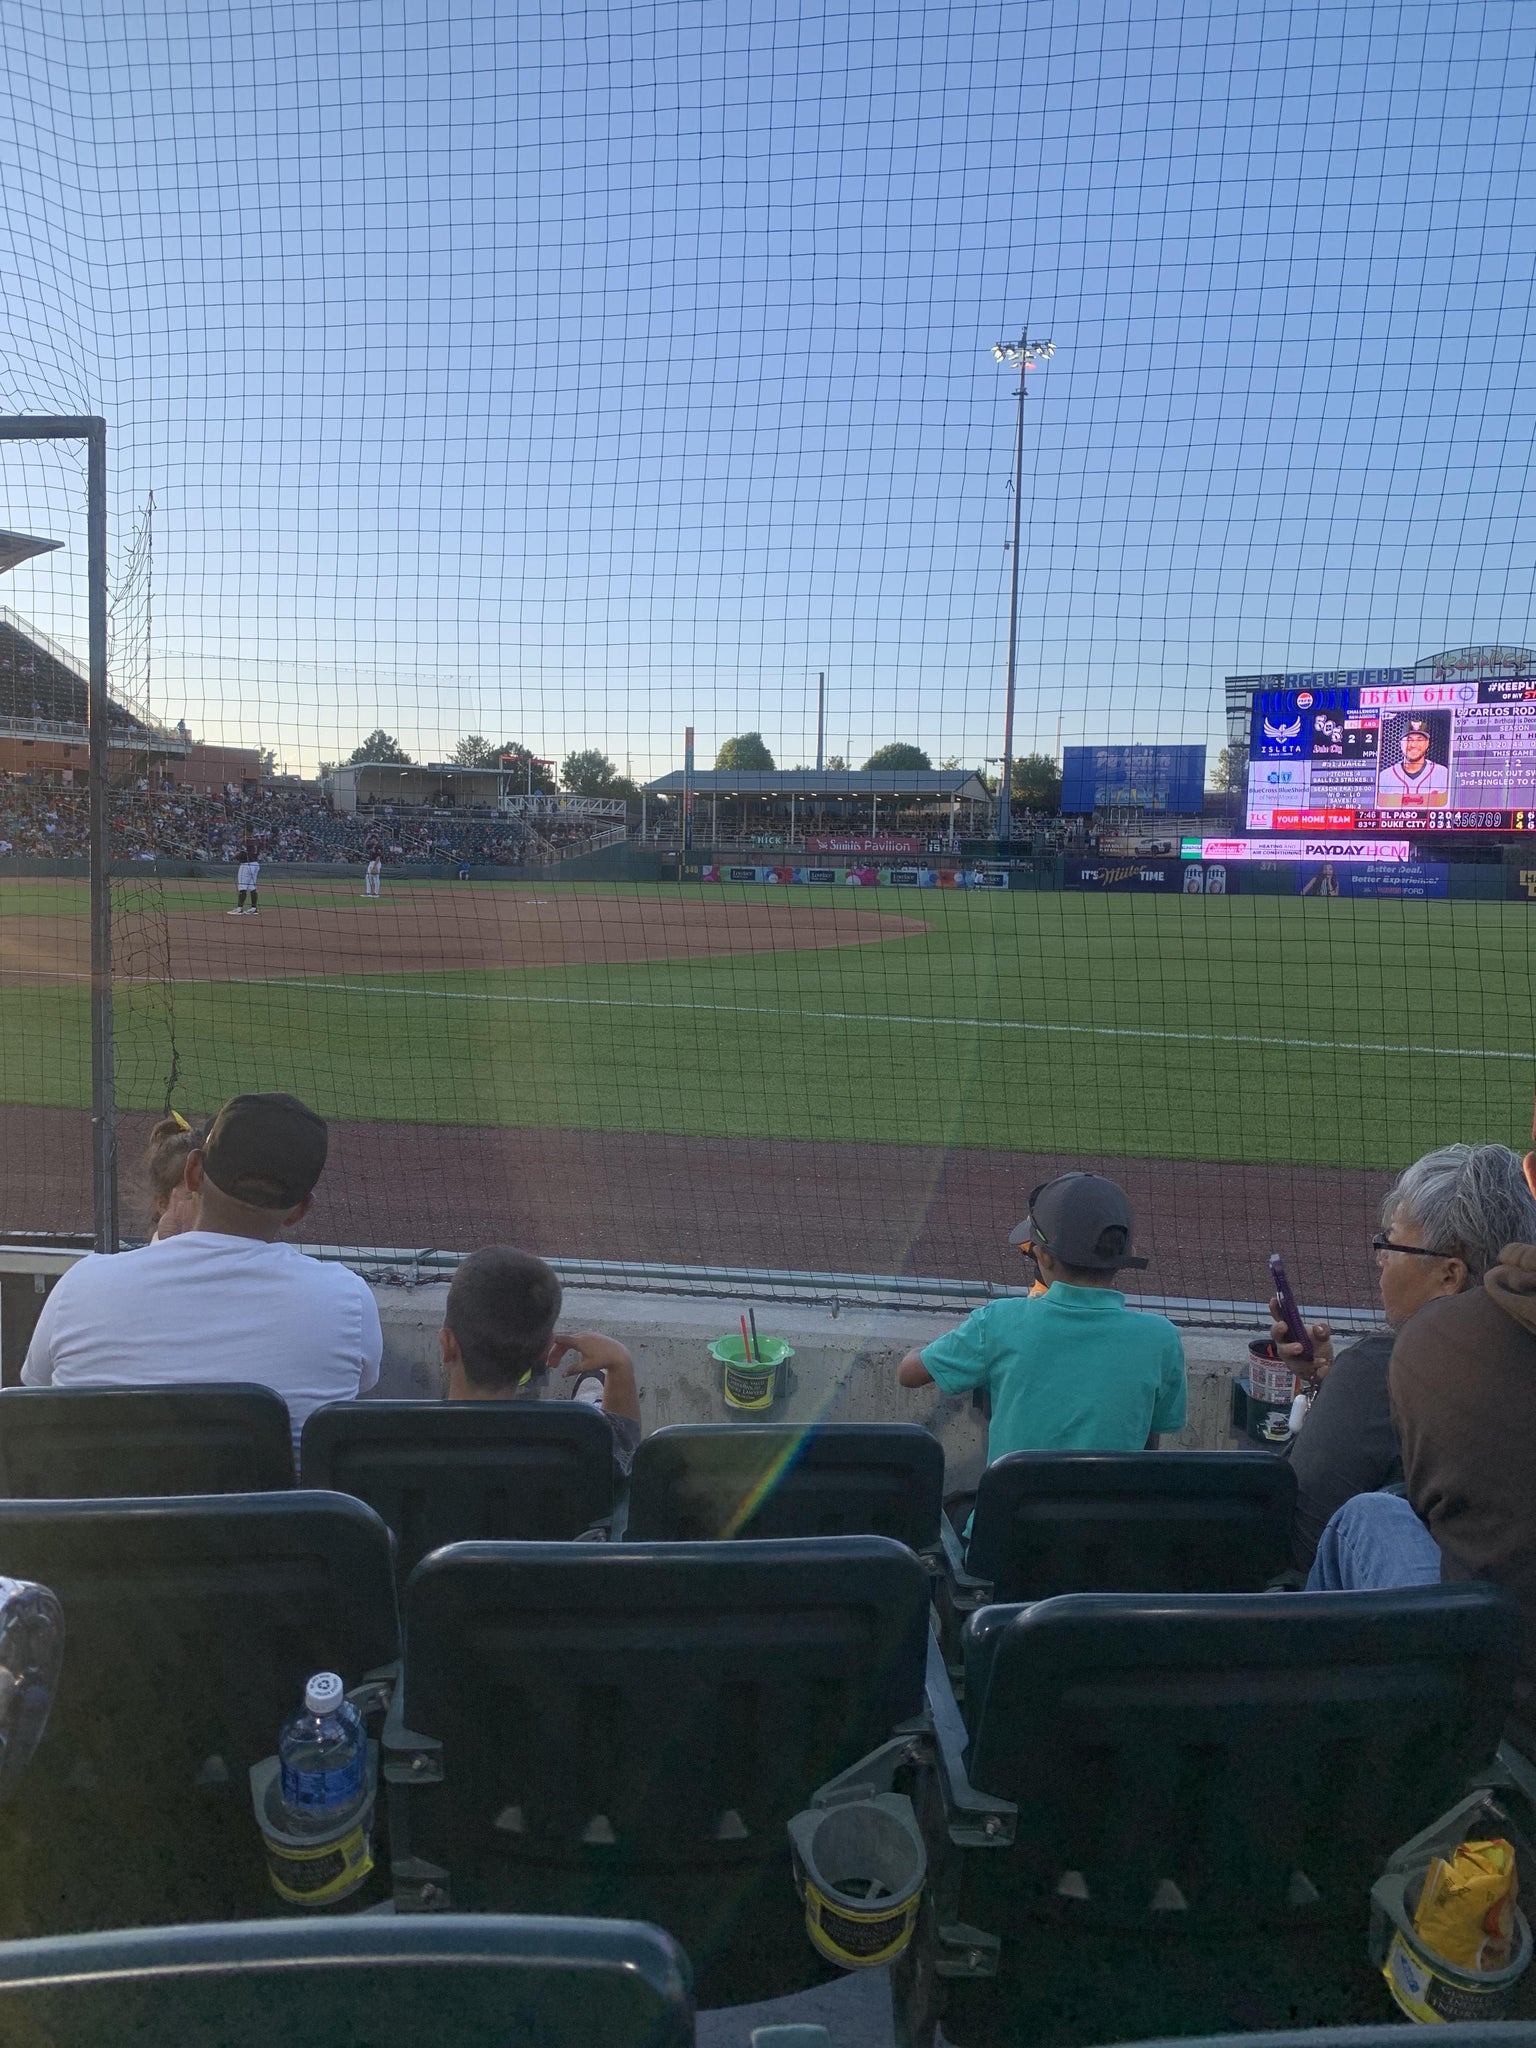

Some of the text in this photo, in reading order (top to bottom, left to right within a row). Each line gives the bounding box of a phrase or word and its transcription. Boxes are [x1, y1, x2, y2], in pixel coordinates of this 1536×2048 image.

[1346, 668, 1403, 687] FIELD
[1488, 681, 1536, 692] #KEEPLI
[1424, 687, 1454, 703] 611
[1469, 707, 1510, 716] CARLOS
[1348, 733, 1372, 743] 2 2
[1261, 745, 1301, 753] ISLETA
[1363, 750, 1378, 758] MPH
[1250, 812, 1351, 823] TLC YOUR HOME TEAM
[1359, 811, 1376, 819] 7:46
[1381, 811, 1391, 819] EL
[1393, 811, 1418, 819] PASO
[1381, 820, 1404, 828] DUKE
[1406, 820, 1427, 828] CITY
[757, 836, 782, 845] NICK
[864, 840, 911, 851] Pavilion
[1260, 863, 1276, 872] 371
[1367, 865, 1396, 873] Better
[1081, 870, 1098, 881] IT'S
[1140, 871, 1165, 881] TIME
[1352, 875, 1382, 883] Better
